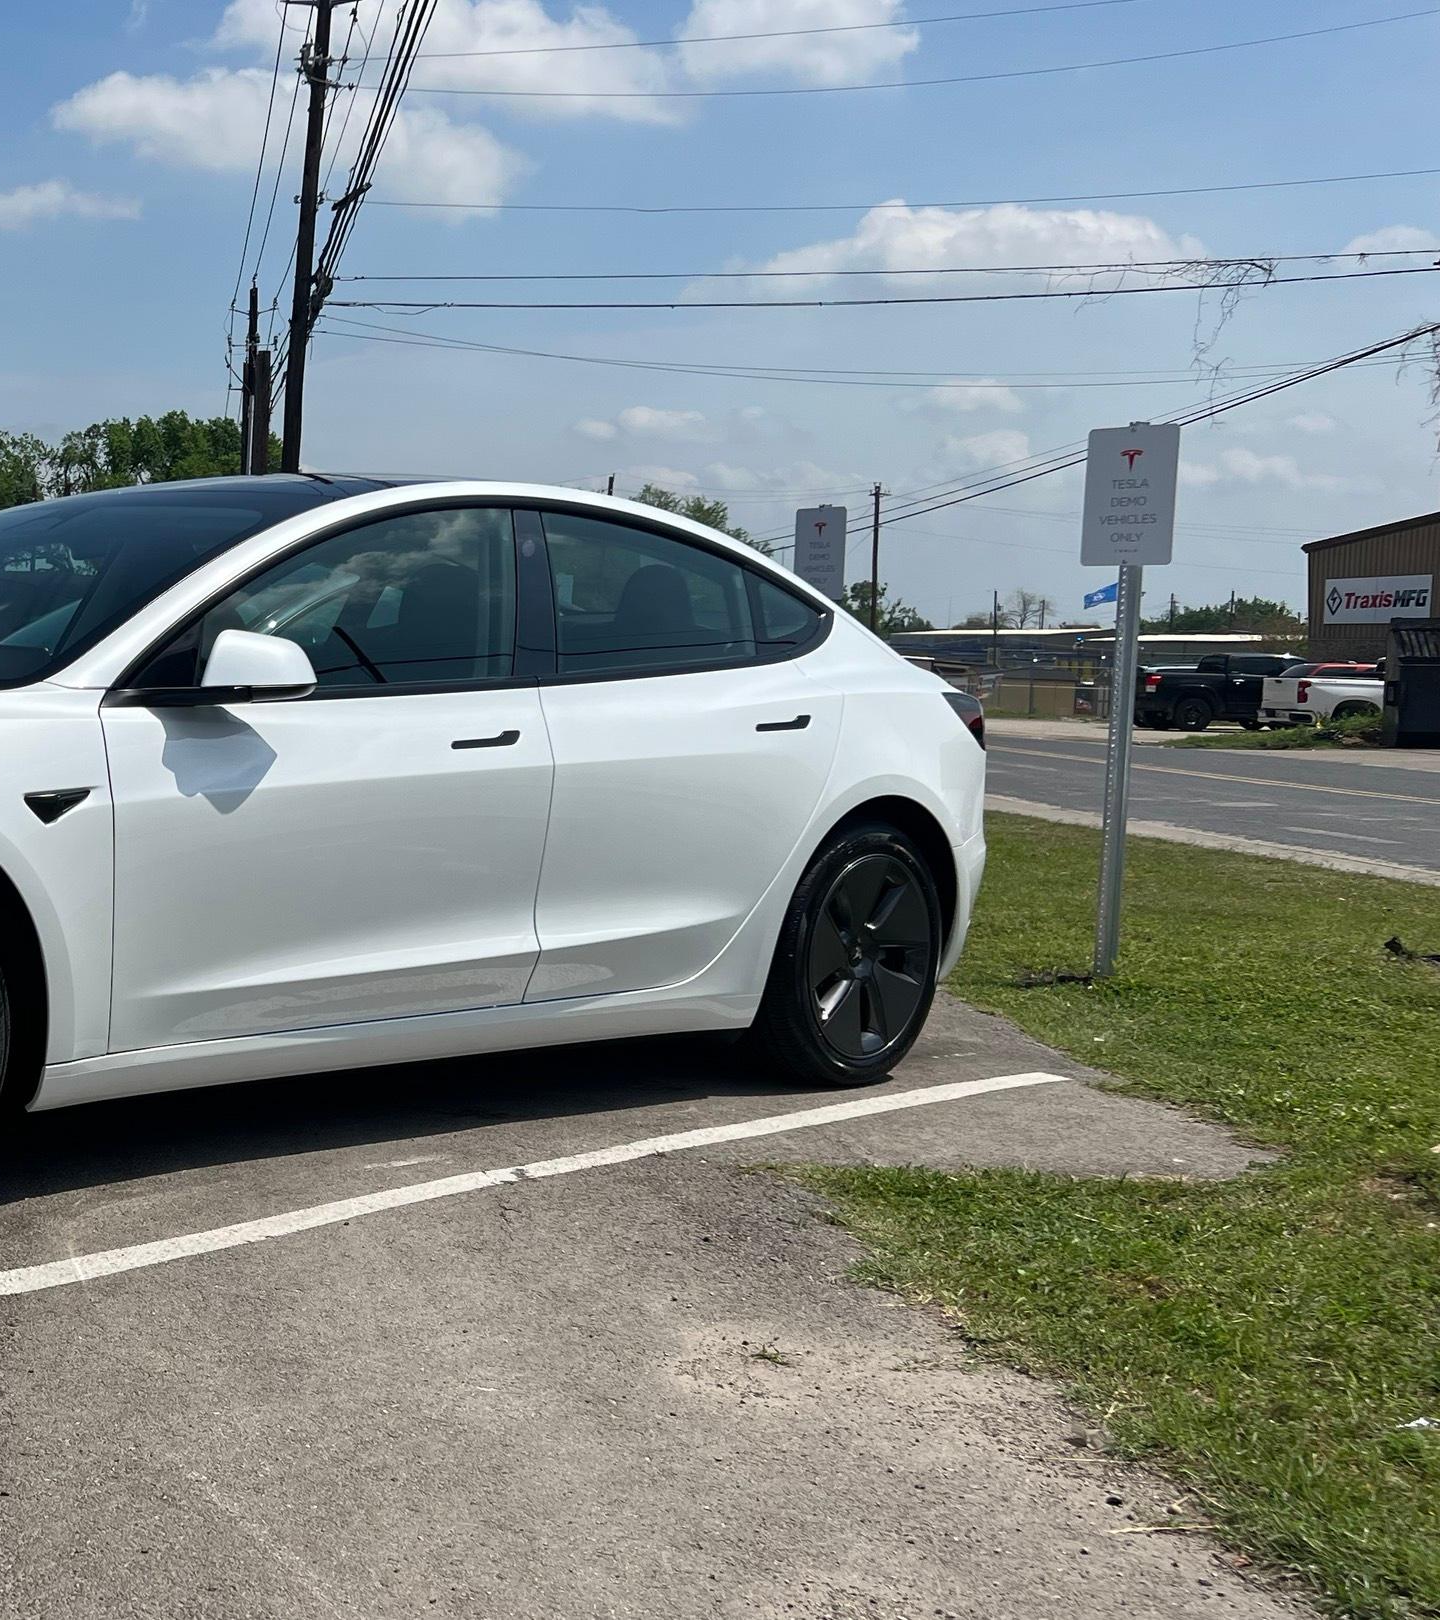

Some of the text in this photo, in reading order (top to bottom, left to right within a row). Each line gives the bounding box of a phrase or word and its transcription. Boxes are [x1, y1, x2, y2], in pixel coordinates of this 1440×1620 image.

[1112, 479, 1149, 489] TESLA
[1111, 497, 1147, 507] DEMO
[1099, 514, 1157, 525] VEHICLES
[1110, 533, 1143, 542] ONLY
